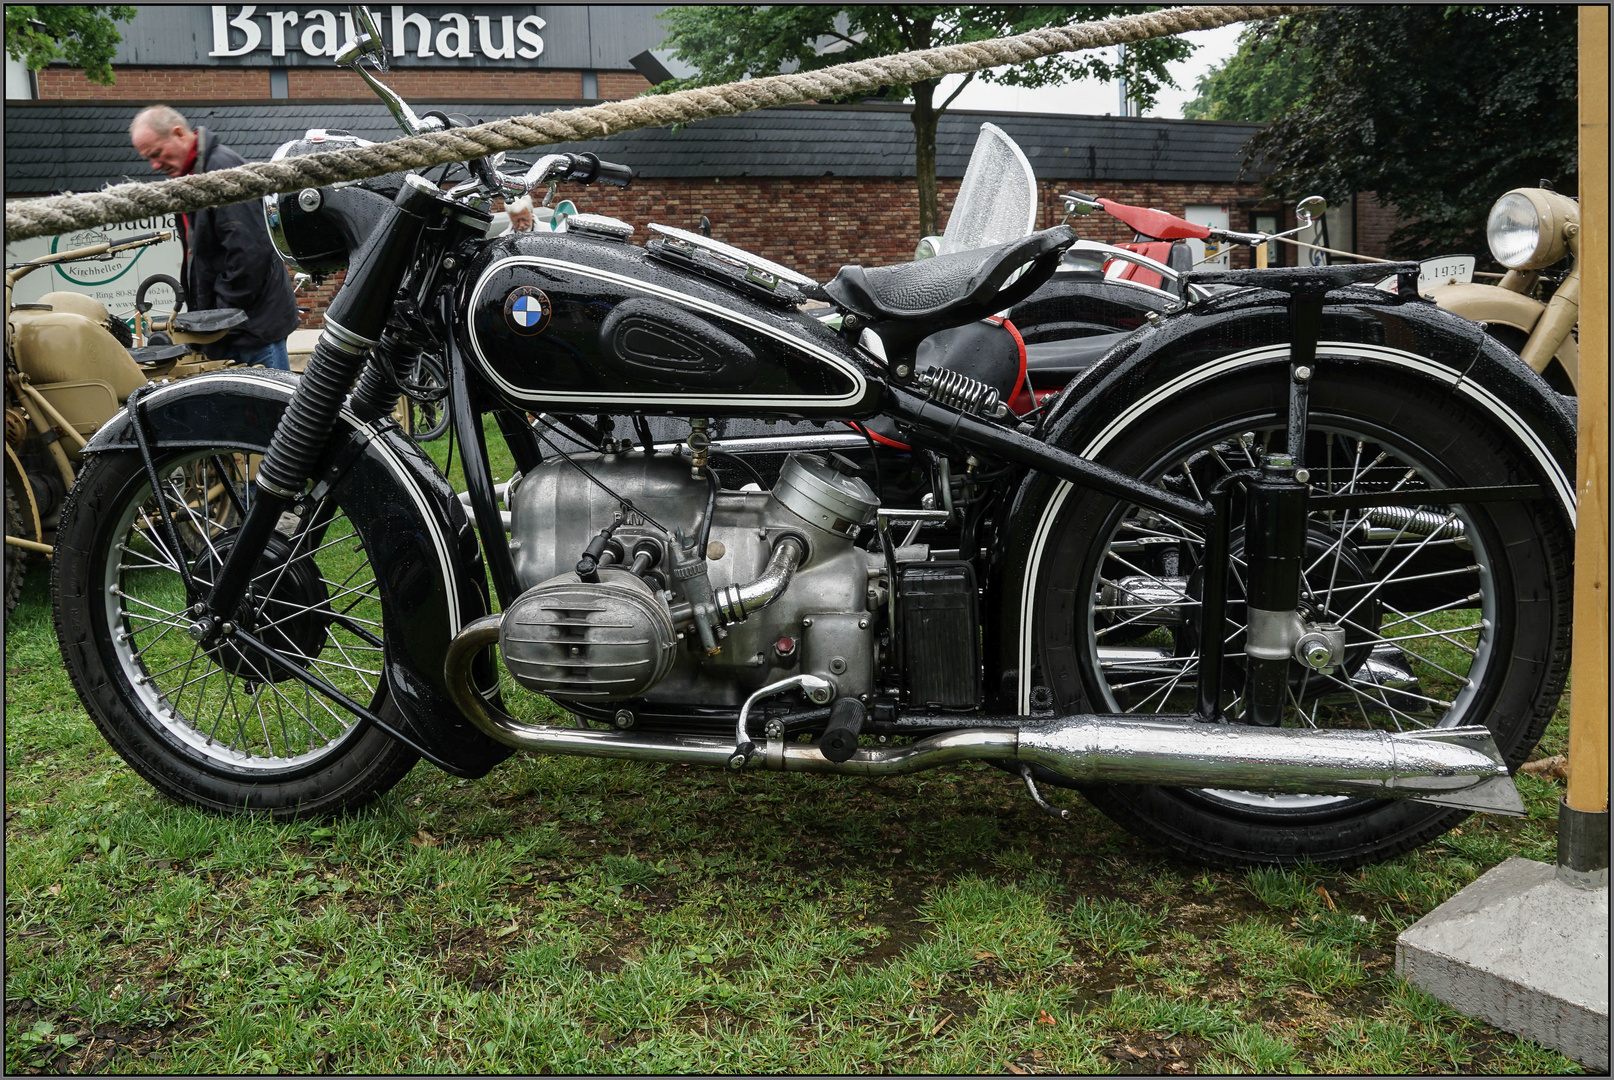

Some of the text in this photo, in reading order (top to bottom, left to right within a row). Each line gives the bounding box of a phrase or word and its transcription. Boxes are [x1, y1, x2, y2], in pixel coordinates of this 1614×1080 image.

[208, 6, 546, 59] Brauhaus
[69, 263, 122, 276] Kirchhellen
[1435, 263, 1465, 278] 1935
[96, 291, 113, 300] Ring
[115, 289, 136, 298] 80-82
[510, 287, 548, 303] BMW
